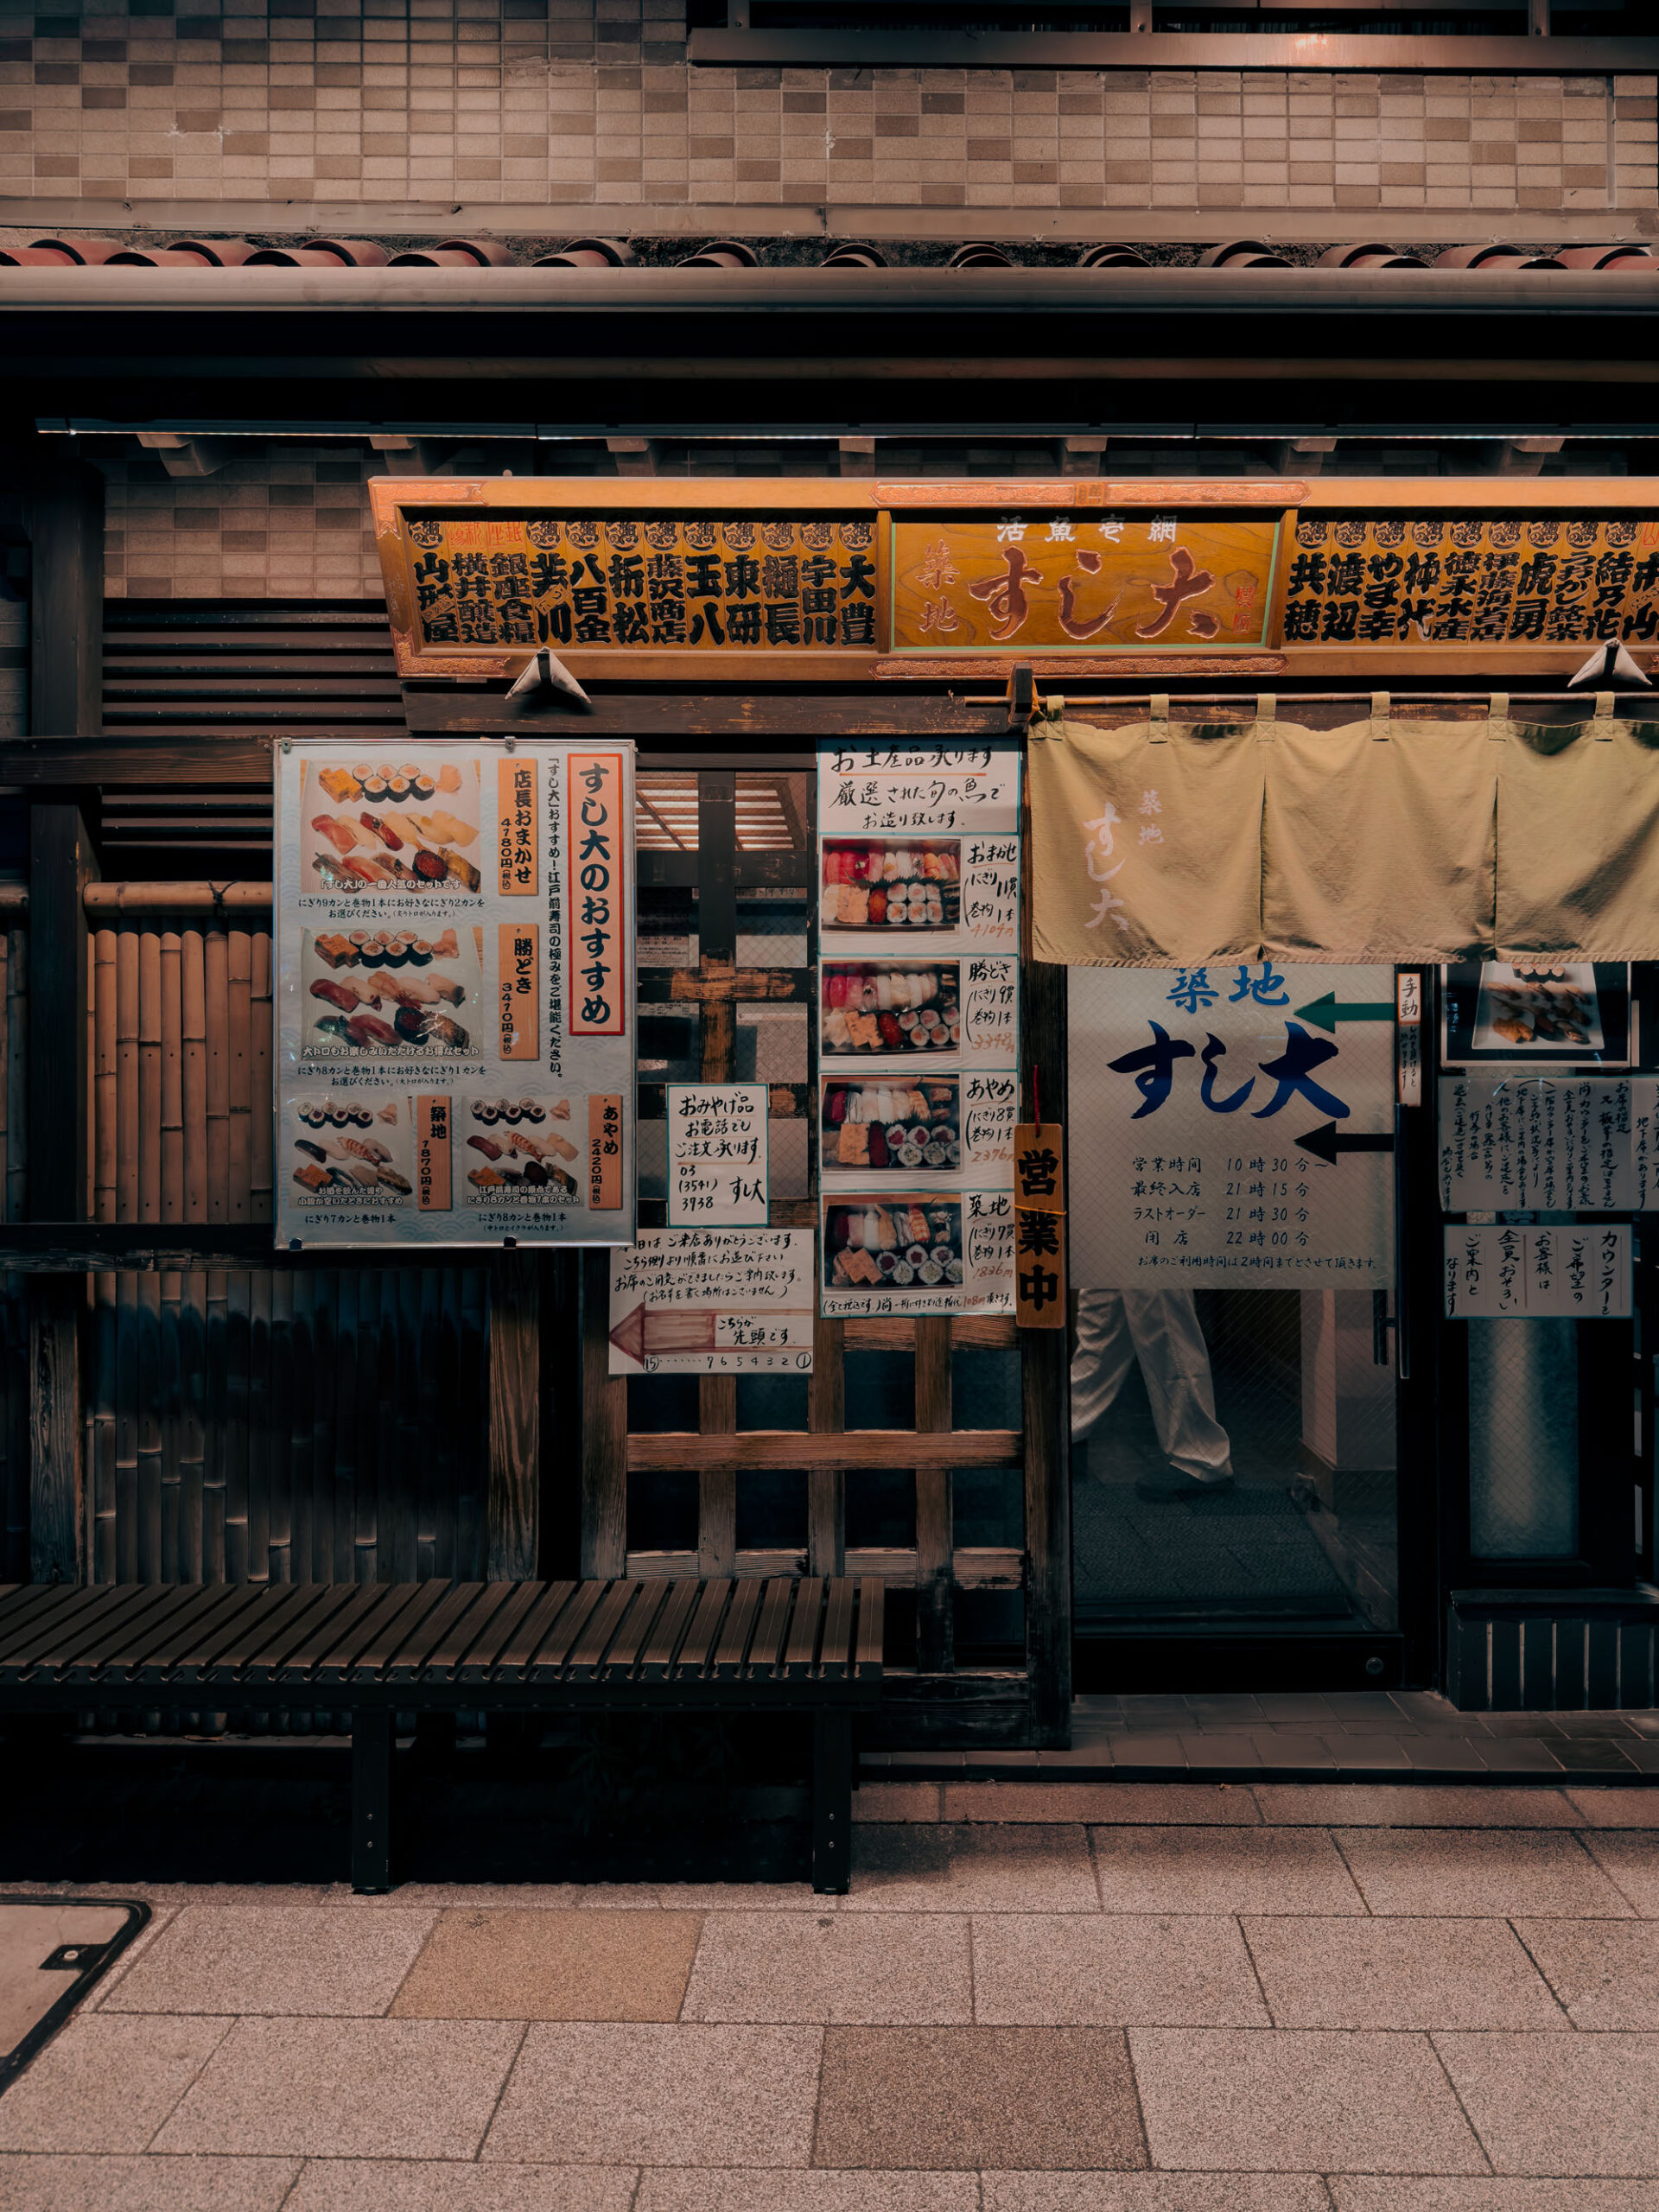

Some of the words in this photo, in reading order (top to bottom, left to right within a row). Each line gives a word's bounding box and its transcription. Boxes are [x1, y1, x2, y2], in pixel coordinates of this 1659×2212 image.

[685, 554, 725, 645] 玉八
[801, 554, 837, 645] 宇田川
[914, 539, 960, 633] 築地
[514, 770, 532, 883] 店長おまかせ
[1137, 789, 1164, 845] 築地
[967, 841, 1017, 863] おまかせ
[1083, 801, 1129, 931] すし大
[579, 762, 611, 1024] すし大のおすすめ
[514, 938, 533, 994] 勝どき
[969, 959, 1011, 982] 勝どき
[1166, 962, 1290, 1014] 築地
[1401, 977, 1418, 1018] 手動
[967, 1077, 1015, 1104] あやめ
[1107, 1020, 1351, 1119] すし大
[430, 1106, 447, 1139] 築地
[603, 1105, 619, 1154] あやめ
[679, 1091, 754, 1116] おみやげ品
[685, 1119, 751, 1137] お電話でも
[680, 1166, 696, 1176] 03
[729, 1176, 766, 1205] すし大
[1131, 1181, 1201, 1197] 最終入店
[1133, 1157, 1201, 1173] 営業時間
[968, 1194, 1011, 1219] 築地
[1018, 1148, 1059, 1311] 営業中
[1133, 1205, 1206, 1221] ラストオーダー
[1446, 1258, 1459, 1316] なります
[1465, 1233, 1483, 1295] ご案内と
[1498, 1230, 1521, 1310] 全員おそろい
[1534, 1231, 1553, 1290] お客様は
[1566, 1236, 1588, 1304] ご希望の
[1599, 1230, 1618, 1315] カウンターを
[718, 1315, 755, 1330] こちらが
